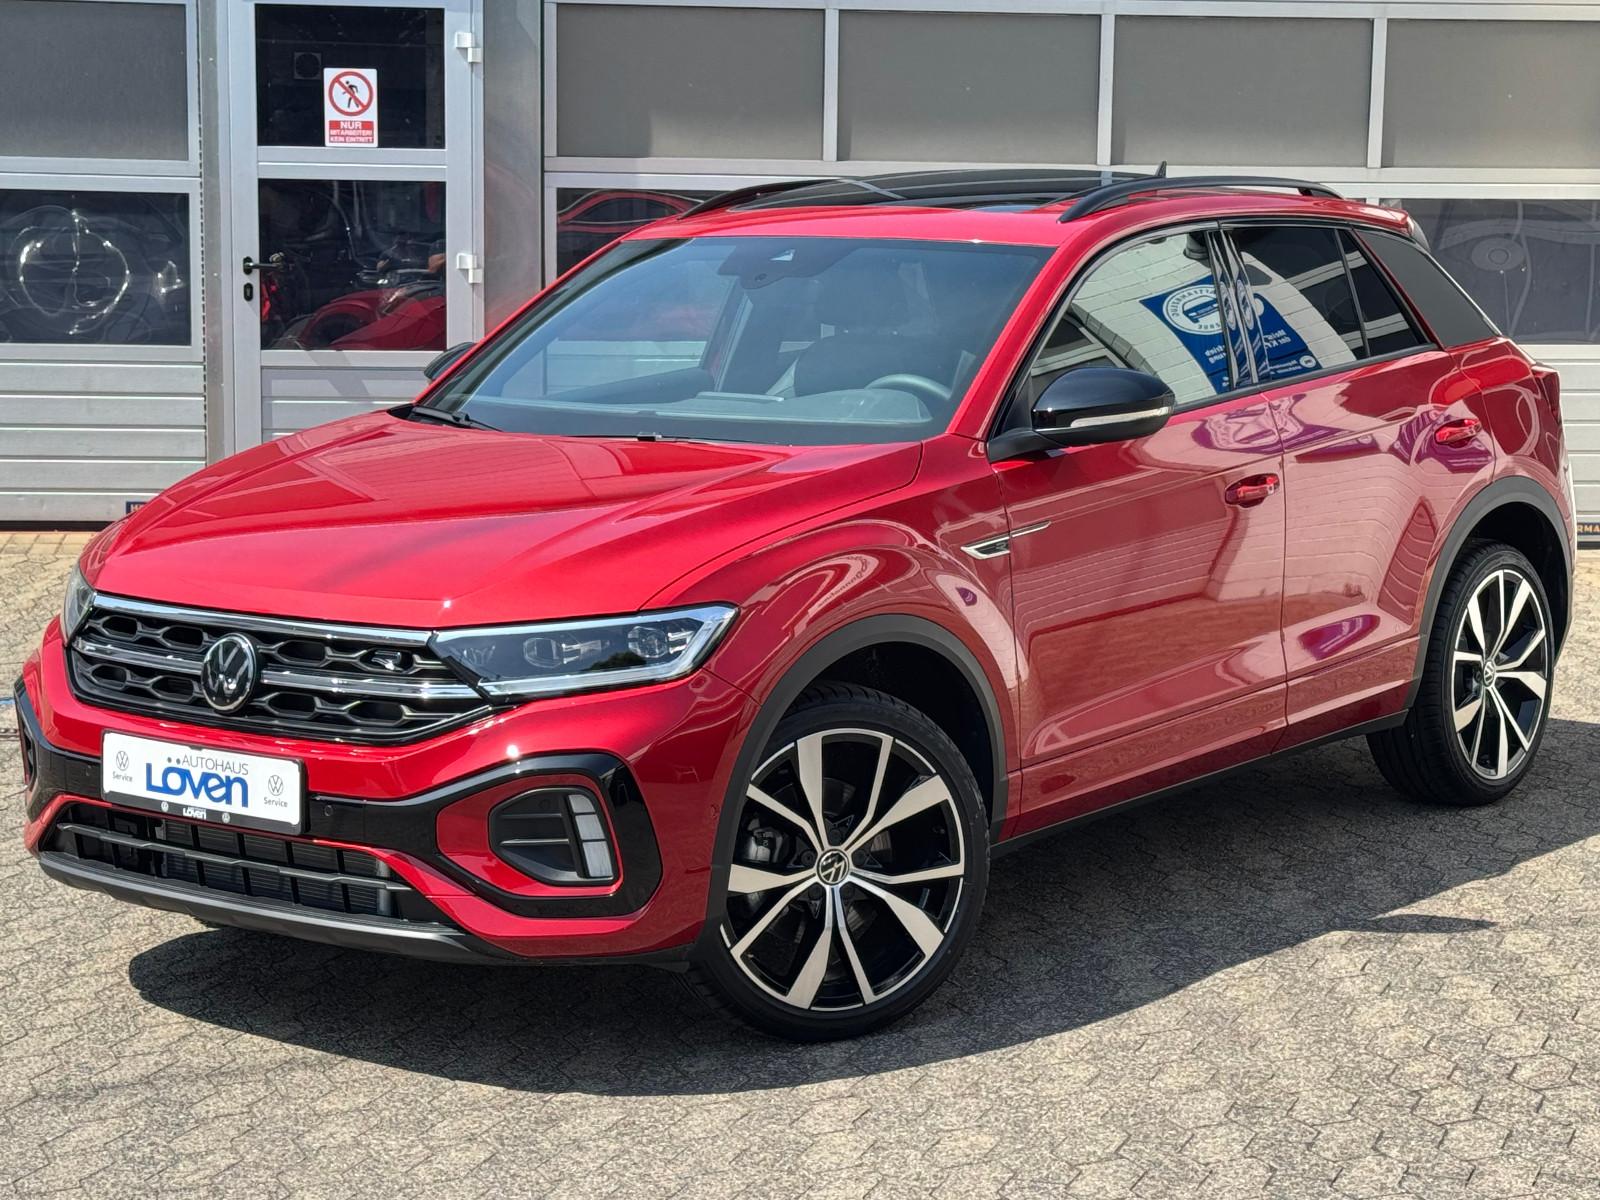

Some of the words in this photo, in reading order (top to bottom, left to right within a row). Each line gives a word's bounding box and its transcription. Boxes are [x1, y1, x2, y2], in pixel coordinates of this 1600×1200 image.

[340, 120, 362, 130] NUR
[181, 754, 249, 776] AUTOHAUS
[112, 770, 134, 783] Service
[263, 796, 289, 808] Service
